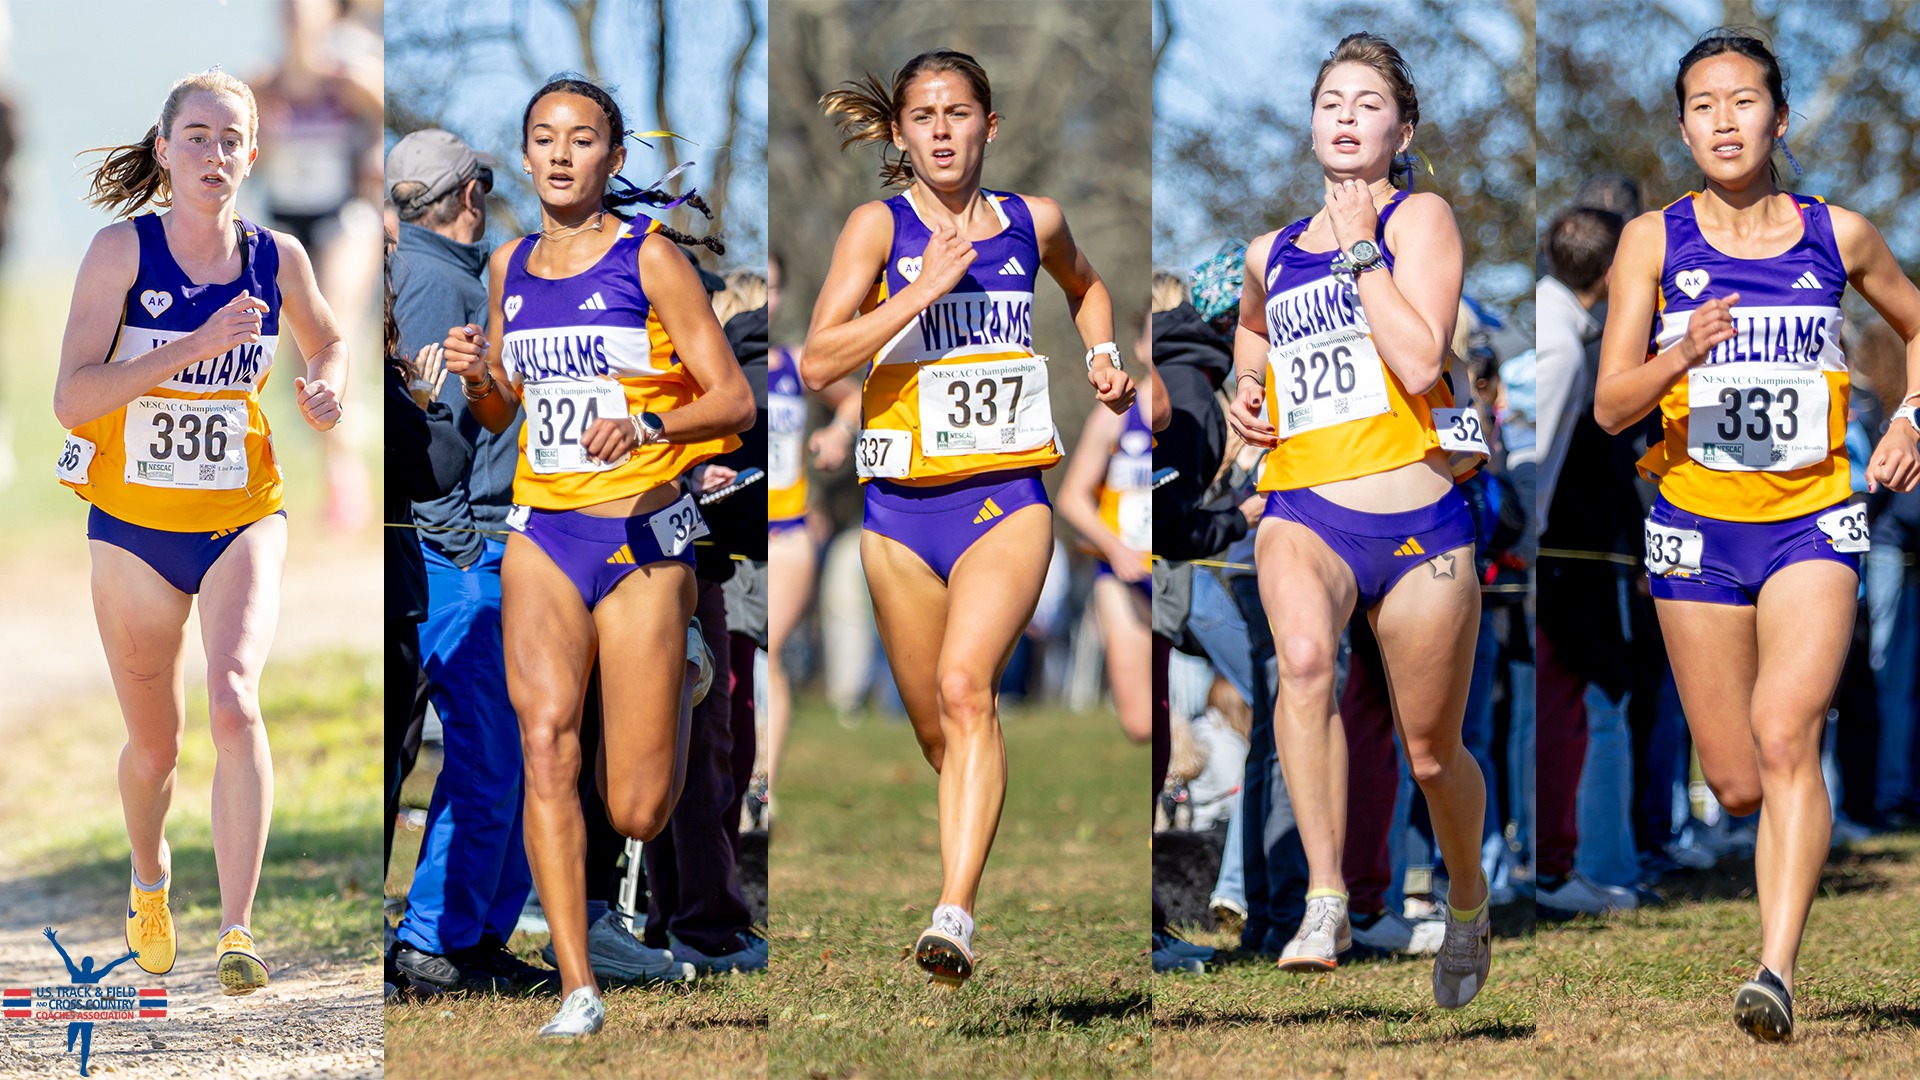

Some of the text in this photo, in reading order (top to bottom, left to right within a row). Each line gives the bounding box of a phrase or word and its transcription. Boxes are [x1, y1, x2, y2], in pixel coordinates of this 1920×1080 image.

[1684, 277, 1700, 287] AK
[148, 296, 165, 307] AK
[508, 302, 518, 310] AK
[918, 301, 1032, 351] WILLIAMS
[1268, 283, 1355, 348] WILLIAMS
[1305, 334, 1359, 351] Championships
[1704, 316, 1827, 364] LLIAMS
[509, 335, 609, 381] WILLIAMS
[931, 364, 1037, 379] NESCAC Championships
[1290, 345, 1356, 406] 326
[1702, 375, 1815, 387] NESCAC Championships
[555, 386, 612, 397] Championships
[947, 375, 1023, 429] 337
[138, 400, 237, 414] NESCAC Championships
[1717, 387, 1799, 441] 333
[149, 412, 228, 462] 336
[949, 431, 975, 440] NESCAC
[1450, 415, 1485, 444] 32
[58, 440, 81, 471] 36
[860, 437, 893, 467] 337
[1716, 445, 1742, 454] NESCAC
[148, 463, 172, 472] NESCAC
